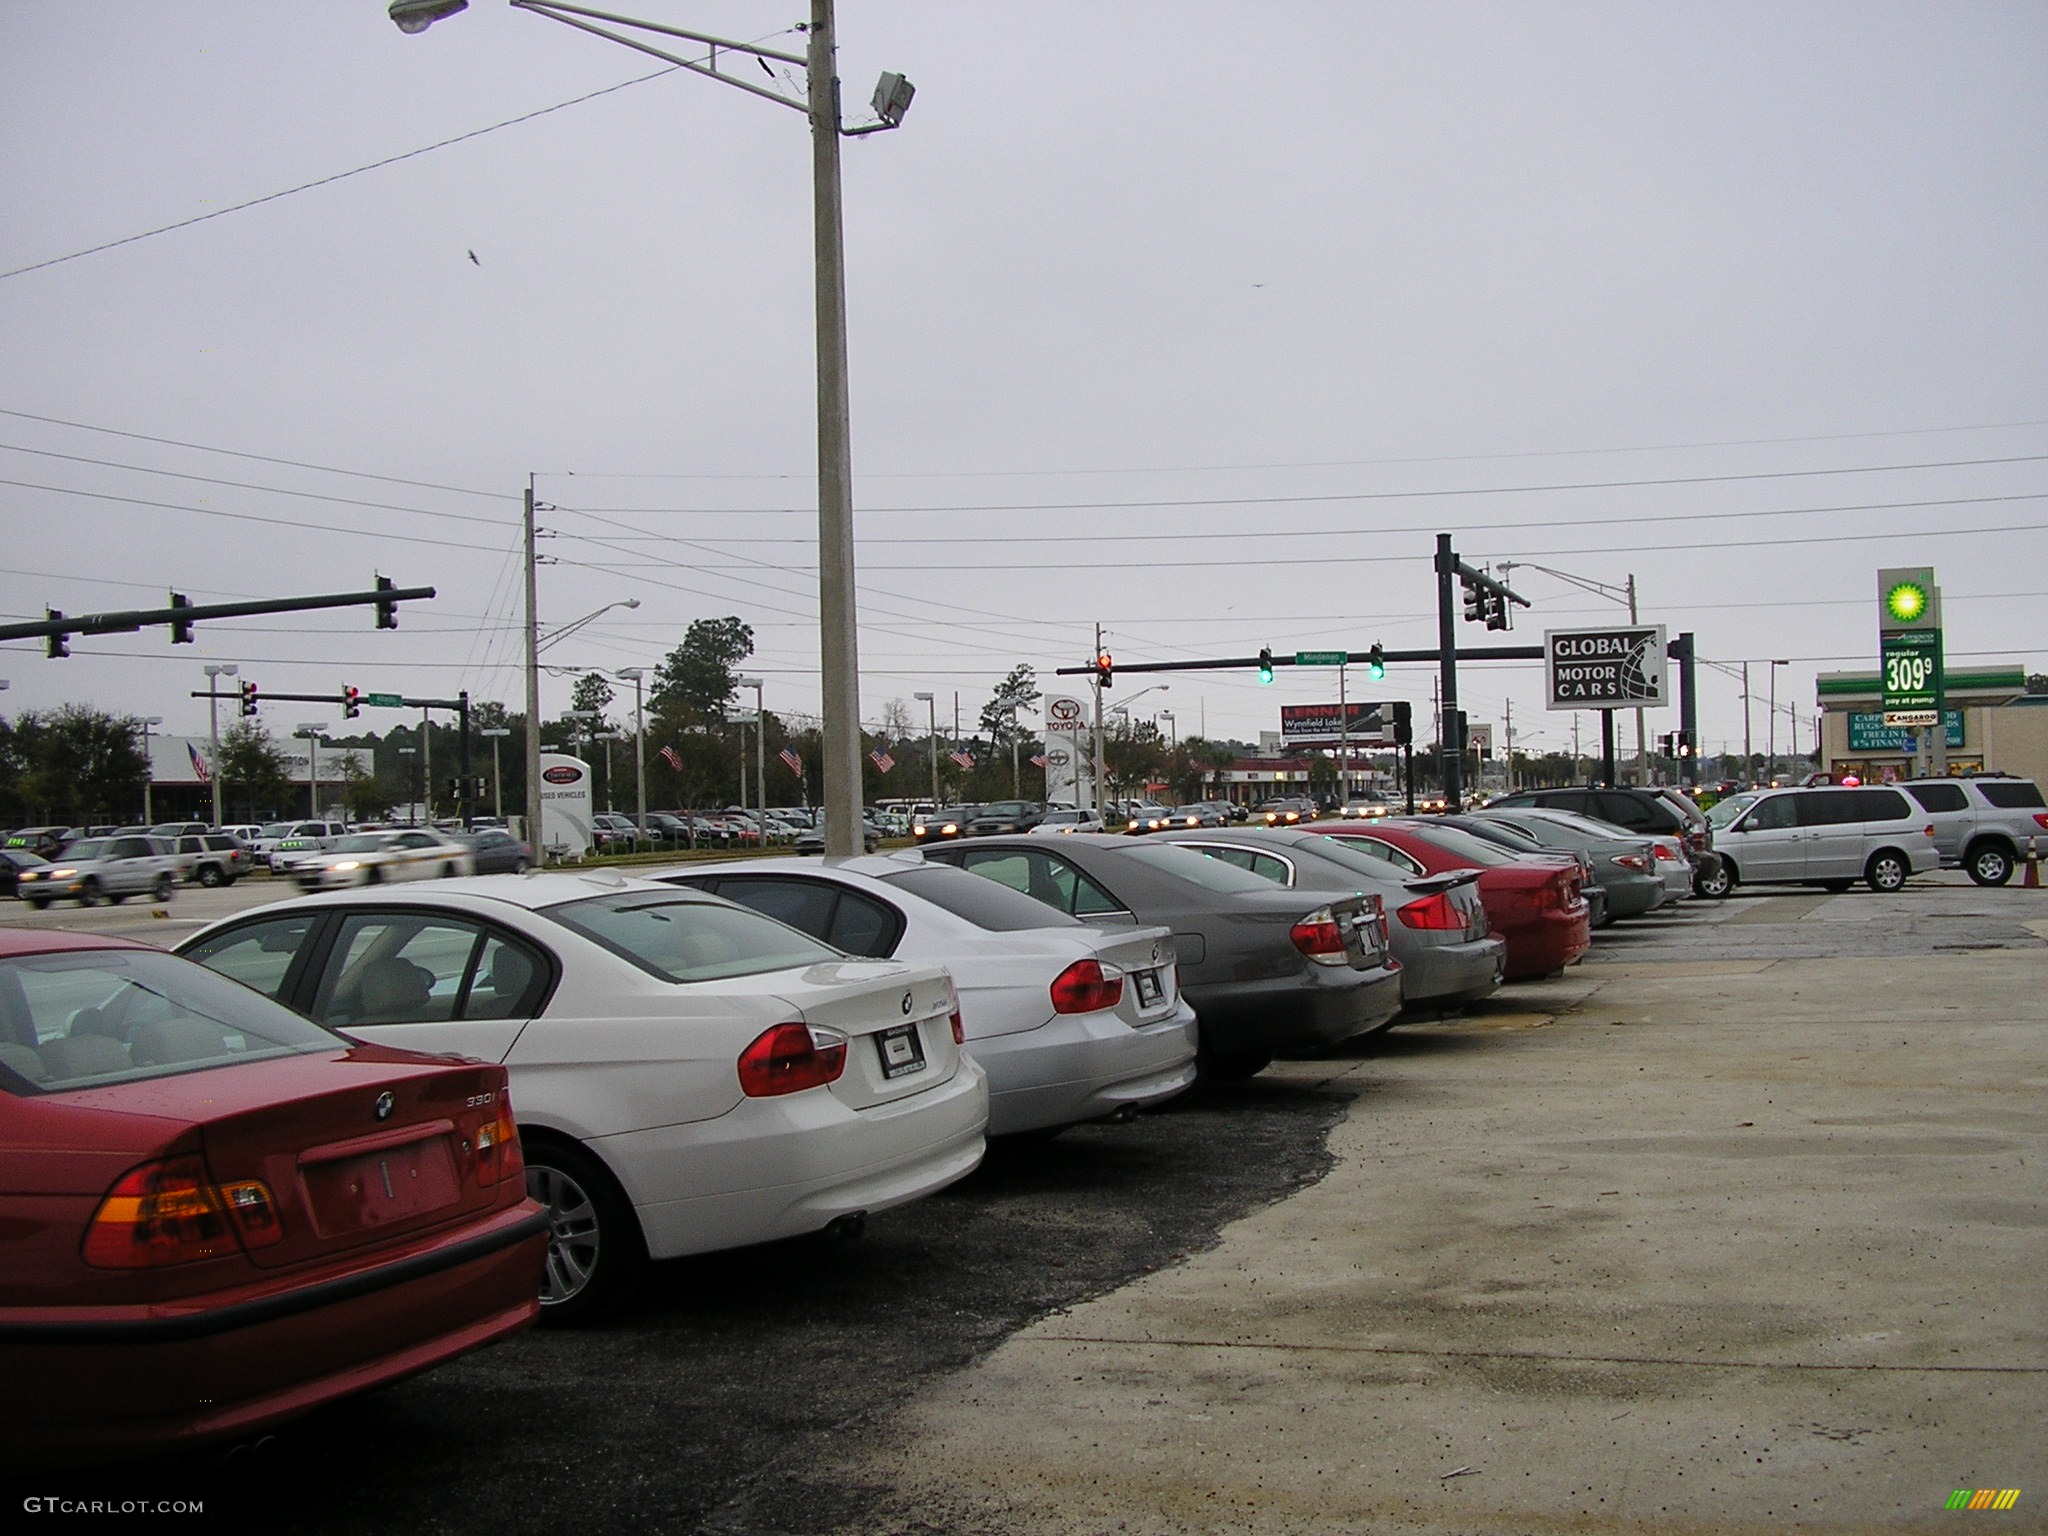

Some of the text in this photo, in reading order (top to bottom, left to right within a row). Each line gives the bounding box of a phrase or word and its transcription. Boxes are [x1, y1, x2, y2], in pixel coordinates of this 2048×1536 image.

[1555, 638, 1632, 656] GLOBAL
[1886, 650, 1920, 658] regular
[1558, 667, 1616, 681] MOTOR
[1558, 682, 1617, 696] CARS
[1911, 697, 1935, 705] pump
[1046, 721, 1086, 731] TOYOA
[1284, 717, 1323, 729] Wynnfield
[557, 791, 586, 799] VEHICLES
